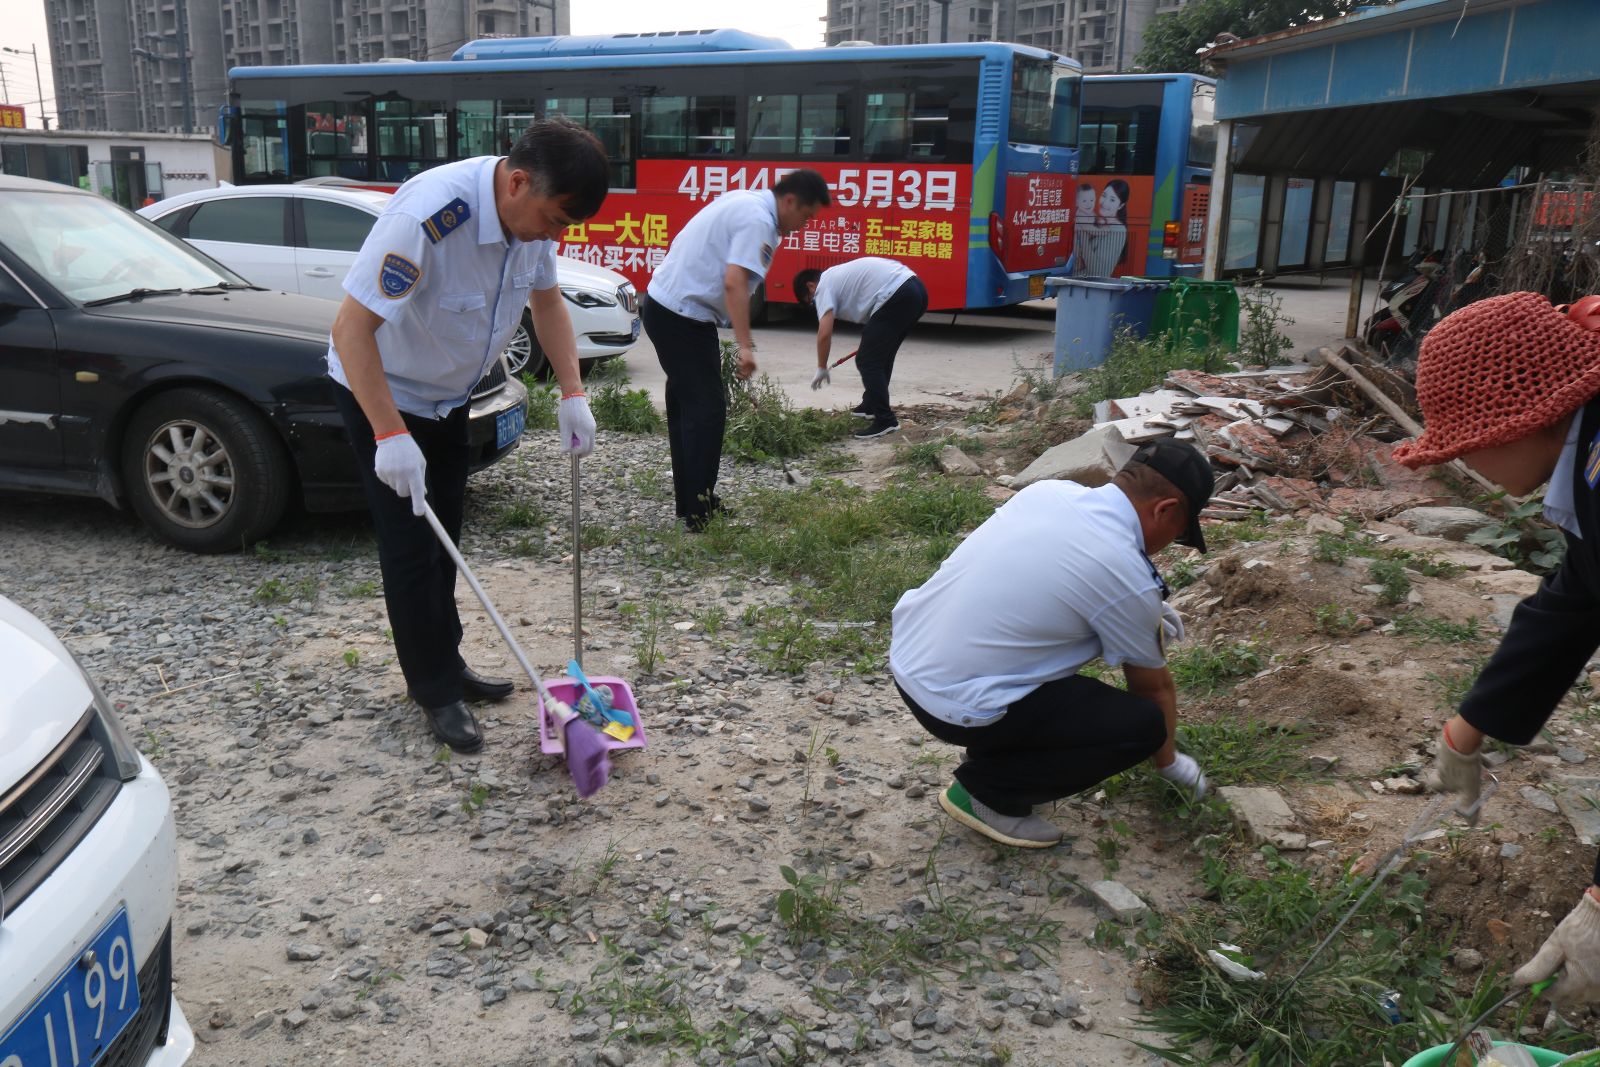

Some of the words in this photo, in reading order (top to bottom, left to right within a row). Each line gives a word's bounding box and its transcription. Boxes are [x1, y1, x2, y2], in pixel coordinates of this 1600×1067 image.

[563, 212, 669, 246] 五一大促
[865, 218, 953, 240] 五一买家电
[784, 230, 861, 254] 五星电器
[865, 238, 953, 260] 就到五星电器
